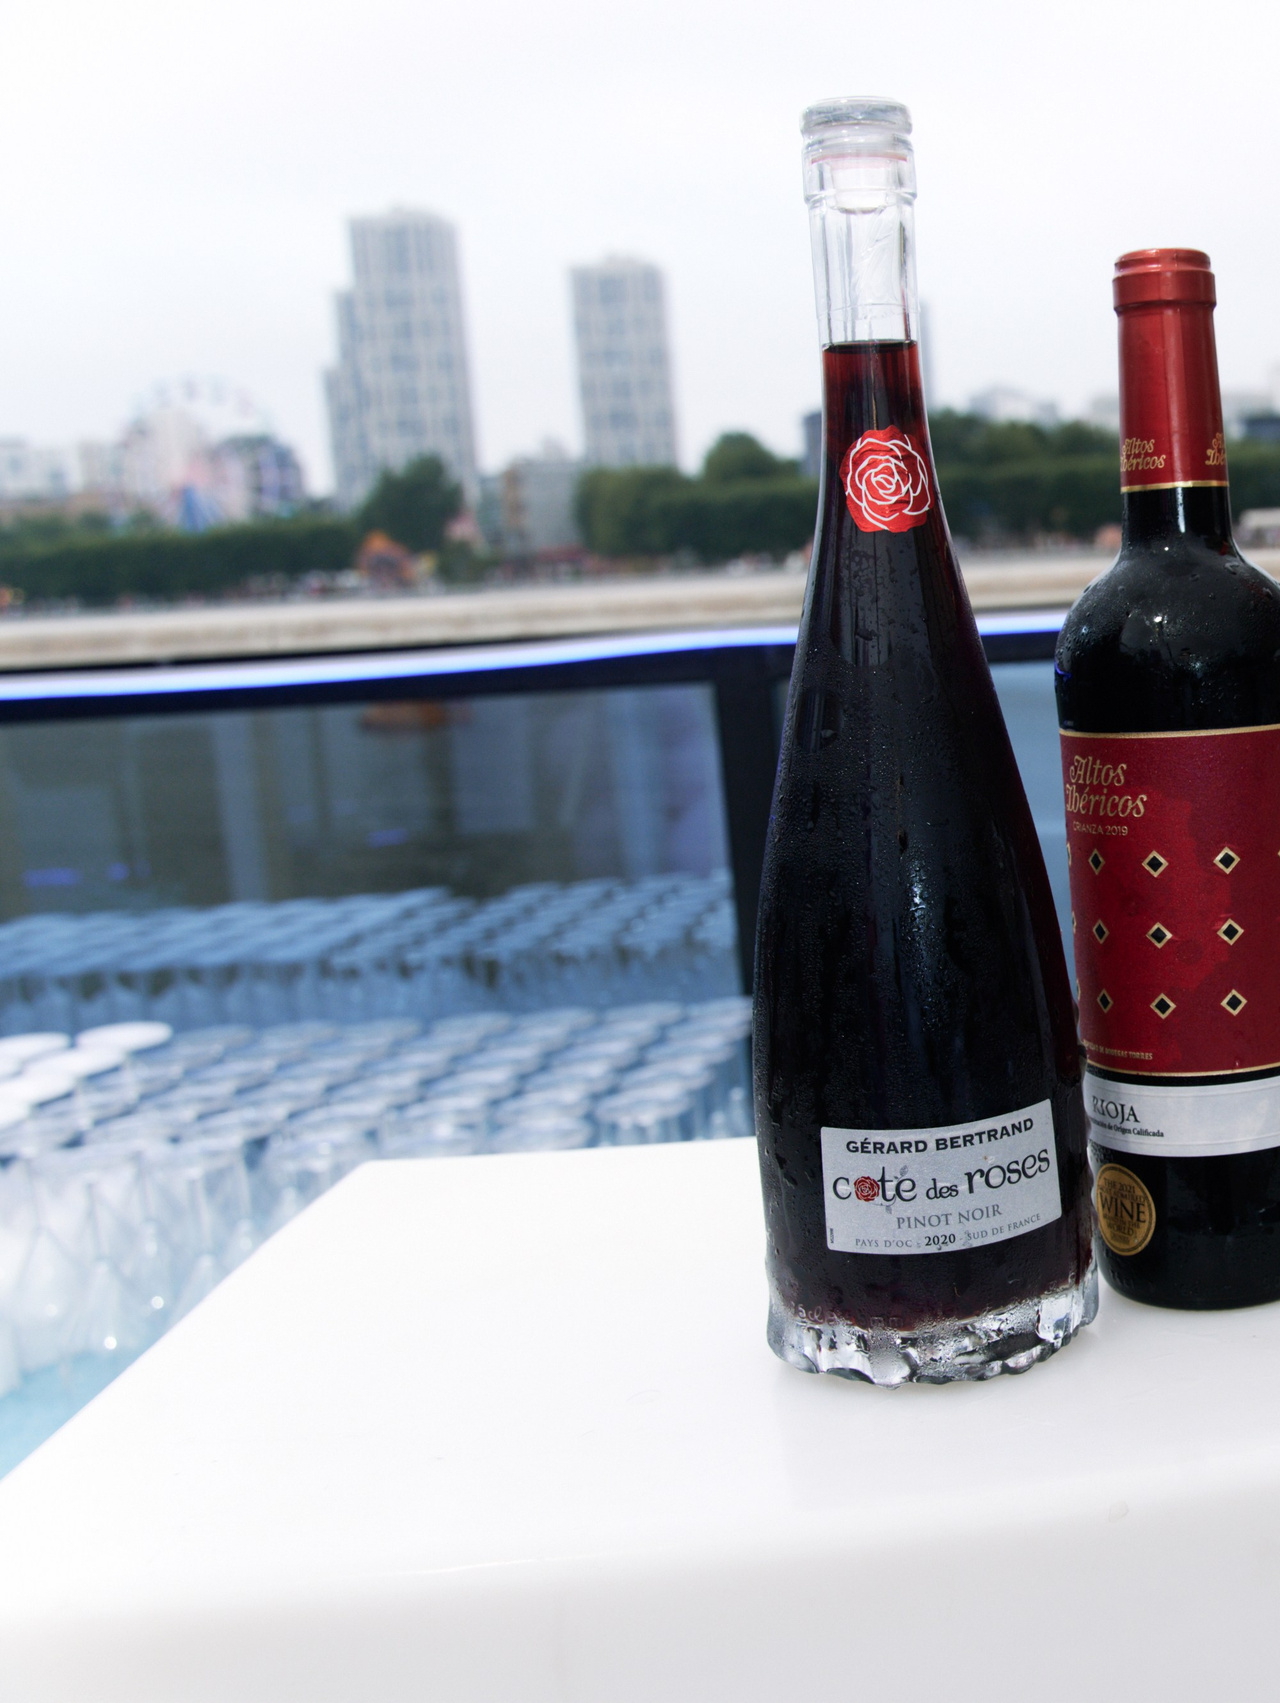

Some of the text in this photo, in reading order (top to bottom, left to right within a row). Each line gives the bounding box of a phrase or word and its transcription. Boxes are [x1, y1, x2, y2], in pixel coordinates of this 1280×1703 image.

[1122, 437, 1155, 455] Altos
[1069, 755, 1127, 786] Altos
[1072, 820, 1129, 837] CRIANZA 2019
[1128, 1051, 1153, 1060] TORRES
[1092, 1095, 1140, 1125] RIOJA
[846, 1117, 1034, 1154] GÉRARD BERTRAND
[1132, 1127, 1164, 1138] Calificada
[925, 1178, 959, 1200] des
[964, 1148, 1050, 1194] roses
[896, 1203, 1002, 1230] PINOT NOIR
[1100, 1191, 1147, 1224] WINE
[855, 1213, 1041, 1248] PAYS D'OC 2020 SUD DE FRANCE
